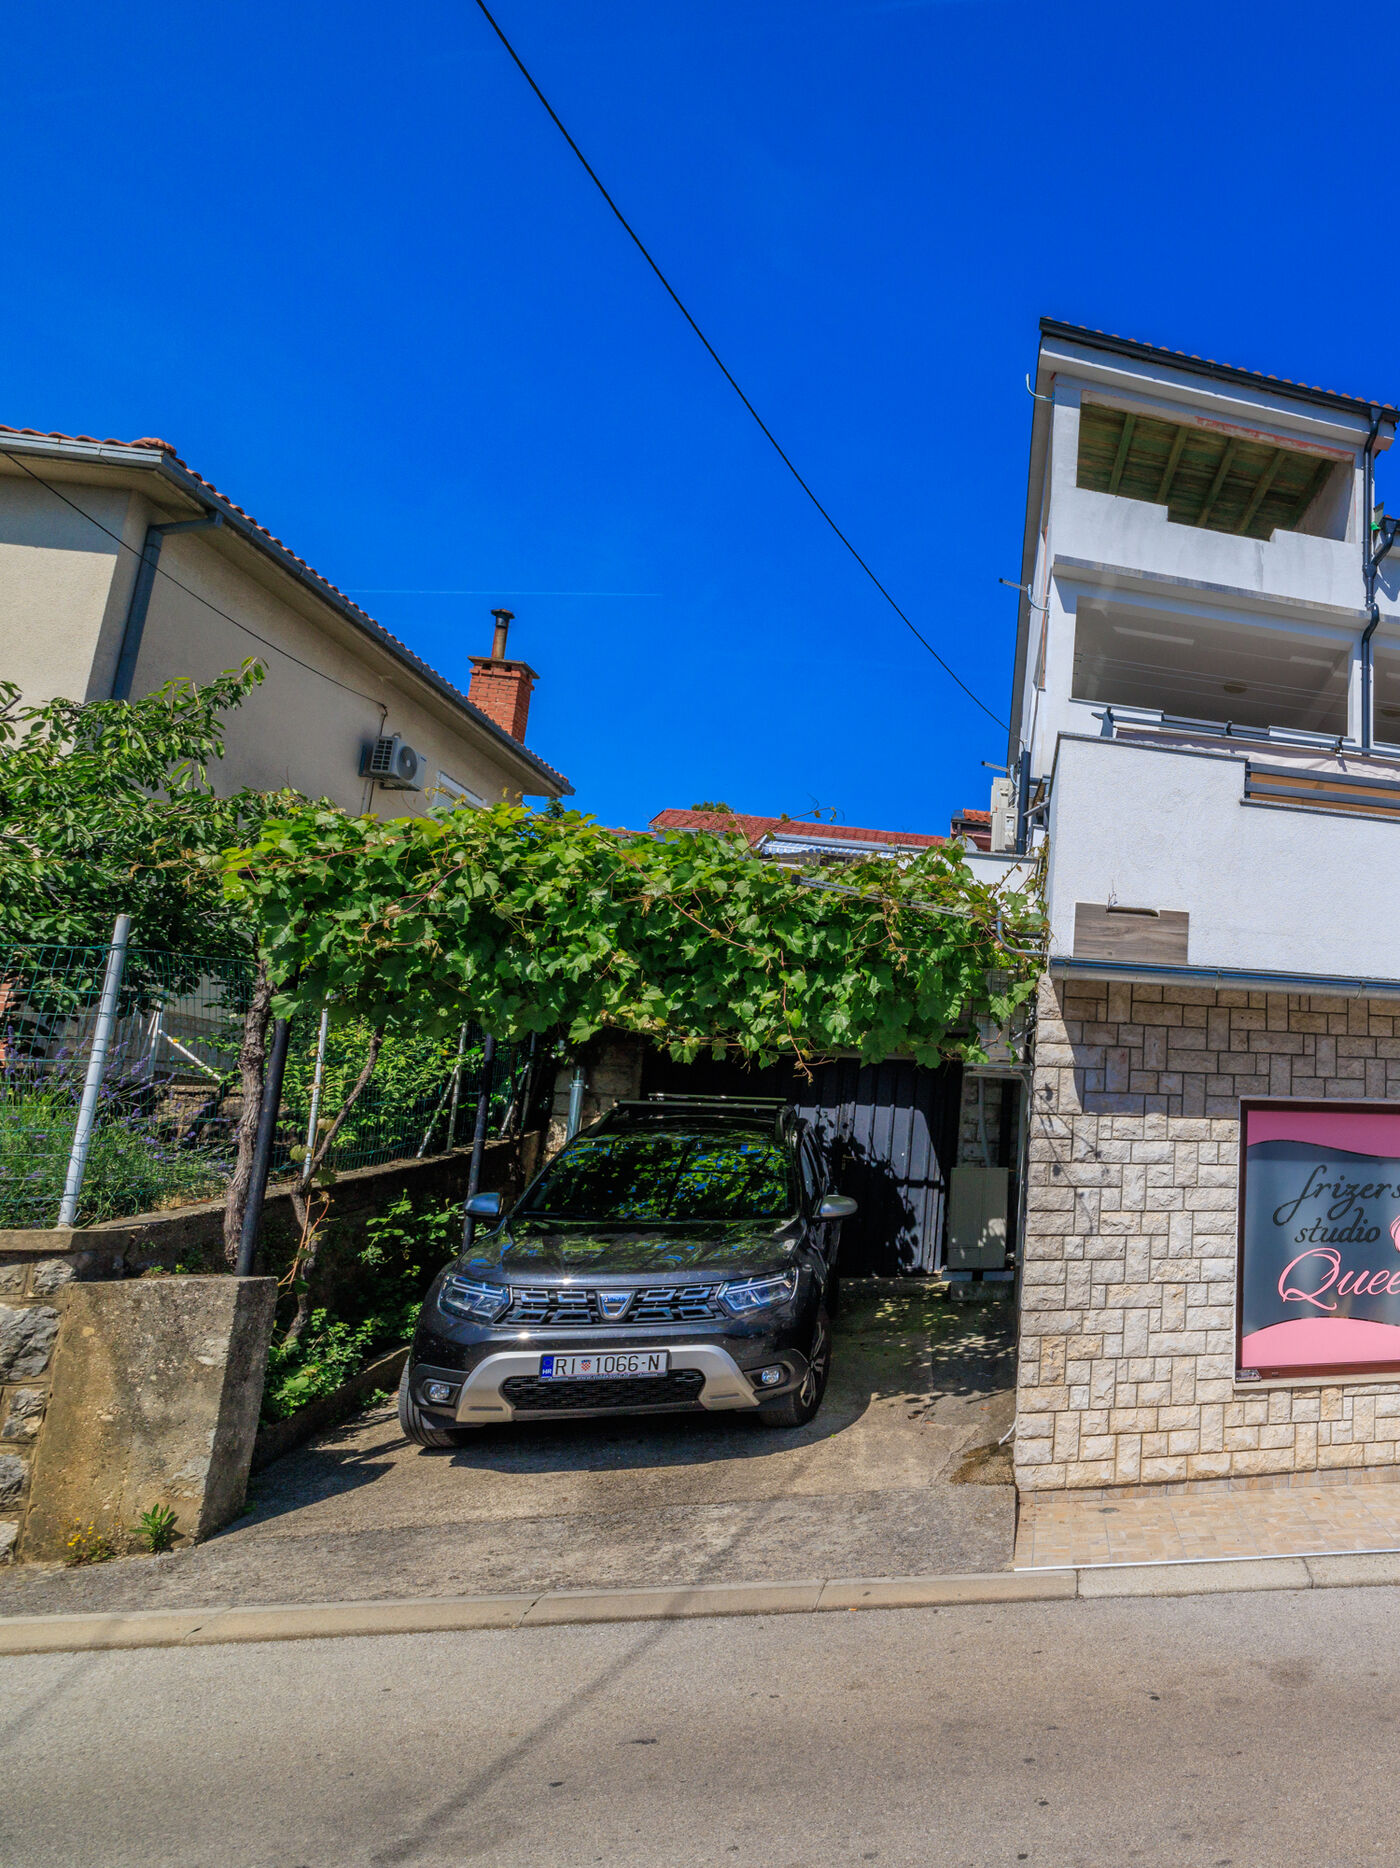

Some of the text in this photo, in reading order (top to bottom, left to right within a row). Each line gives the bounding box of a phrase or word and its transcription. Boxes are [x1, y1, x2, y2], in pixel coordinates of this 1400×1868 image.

[1294, 1206, 1381, 1244] studio
[555, 1354, 660, 1375] RI 1066-N
